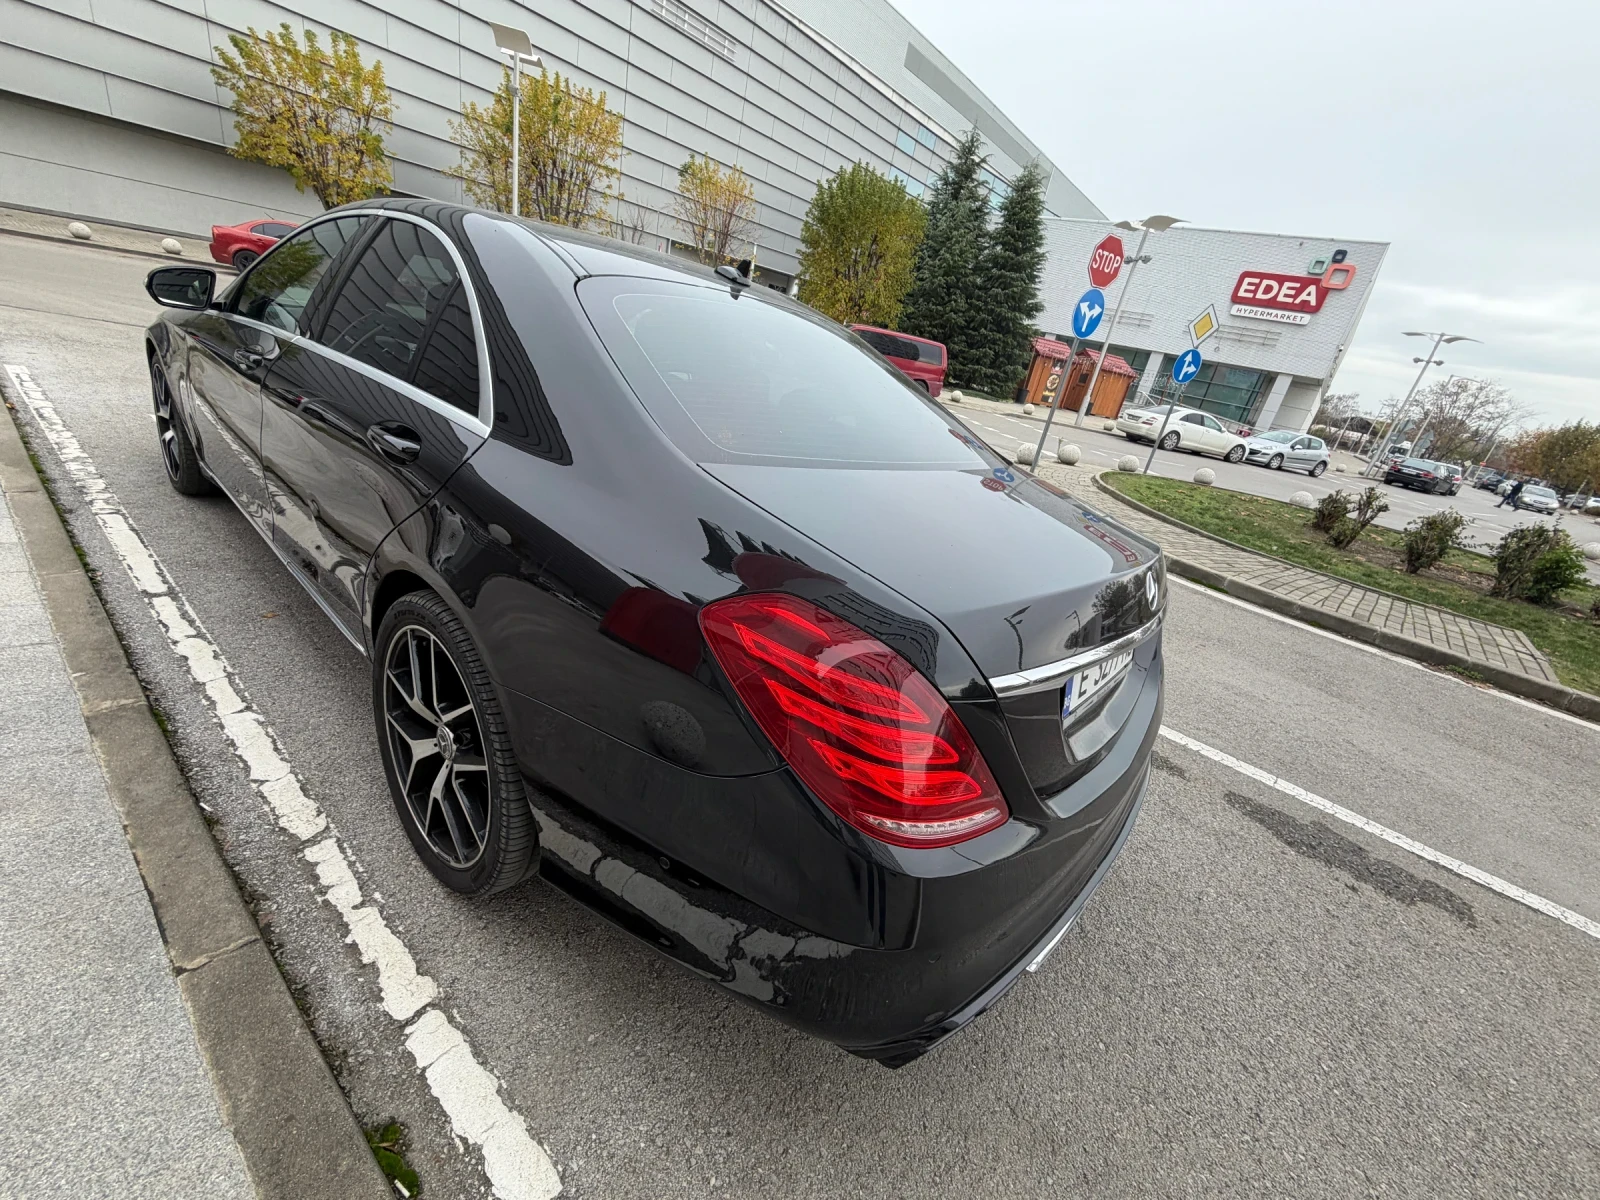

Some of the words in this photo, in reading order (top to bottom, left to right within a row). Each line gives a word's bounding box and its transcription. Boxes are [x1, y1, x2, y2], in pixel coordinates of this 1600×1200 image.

[1092, 249, 1121, 274] STOP
[1237, 277, 1317, 306] EDEA
[1236, 307, 1305, 322] HYPERMARKET
